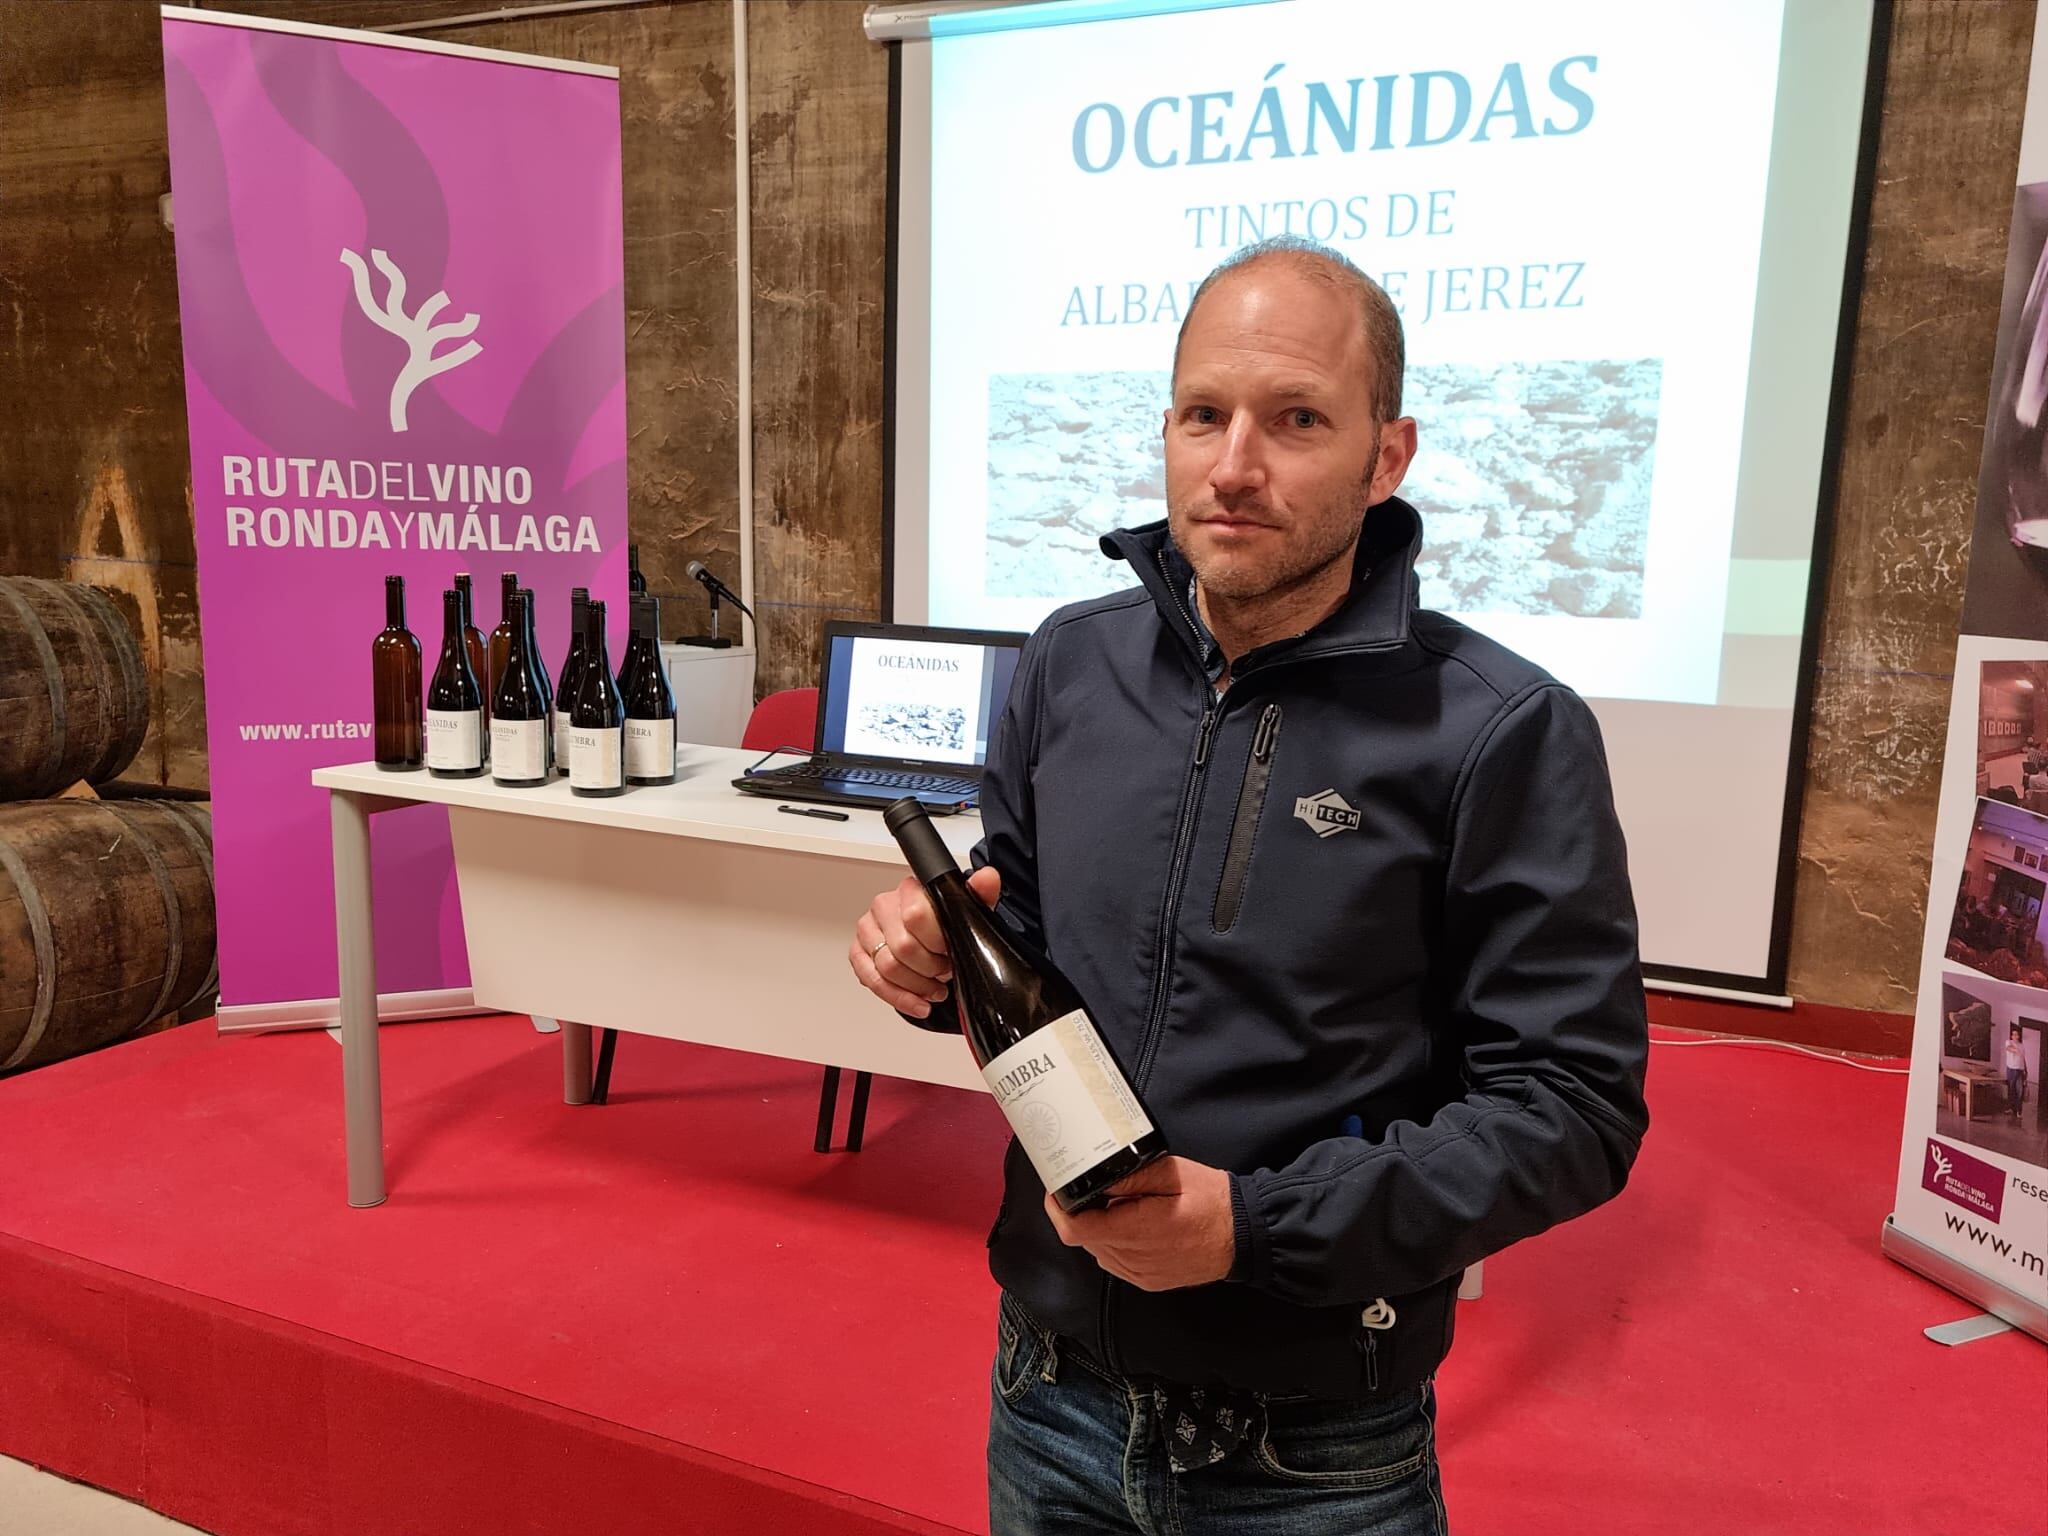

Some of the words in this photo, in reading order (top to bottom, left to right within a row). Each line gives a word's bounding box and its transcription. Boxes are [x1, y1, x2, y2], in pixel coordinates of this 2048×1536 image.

[1072, 54, 1599, 174] OCEÁNIDAS
[1185, 195, 1369, 249] TINTOS
[1386, 189, 1456, 238] DE
[1419, 261, 1586, 325] JEREZ
[223, 455, 533, 504] RUTADELVINO
[226, 503, 602, 553] RONDAYMÁLAGA
[239, 719, 374, 743] www.rutav
